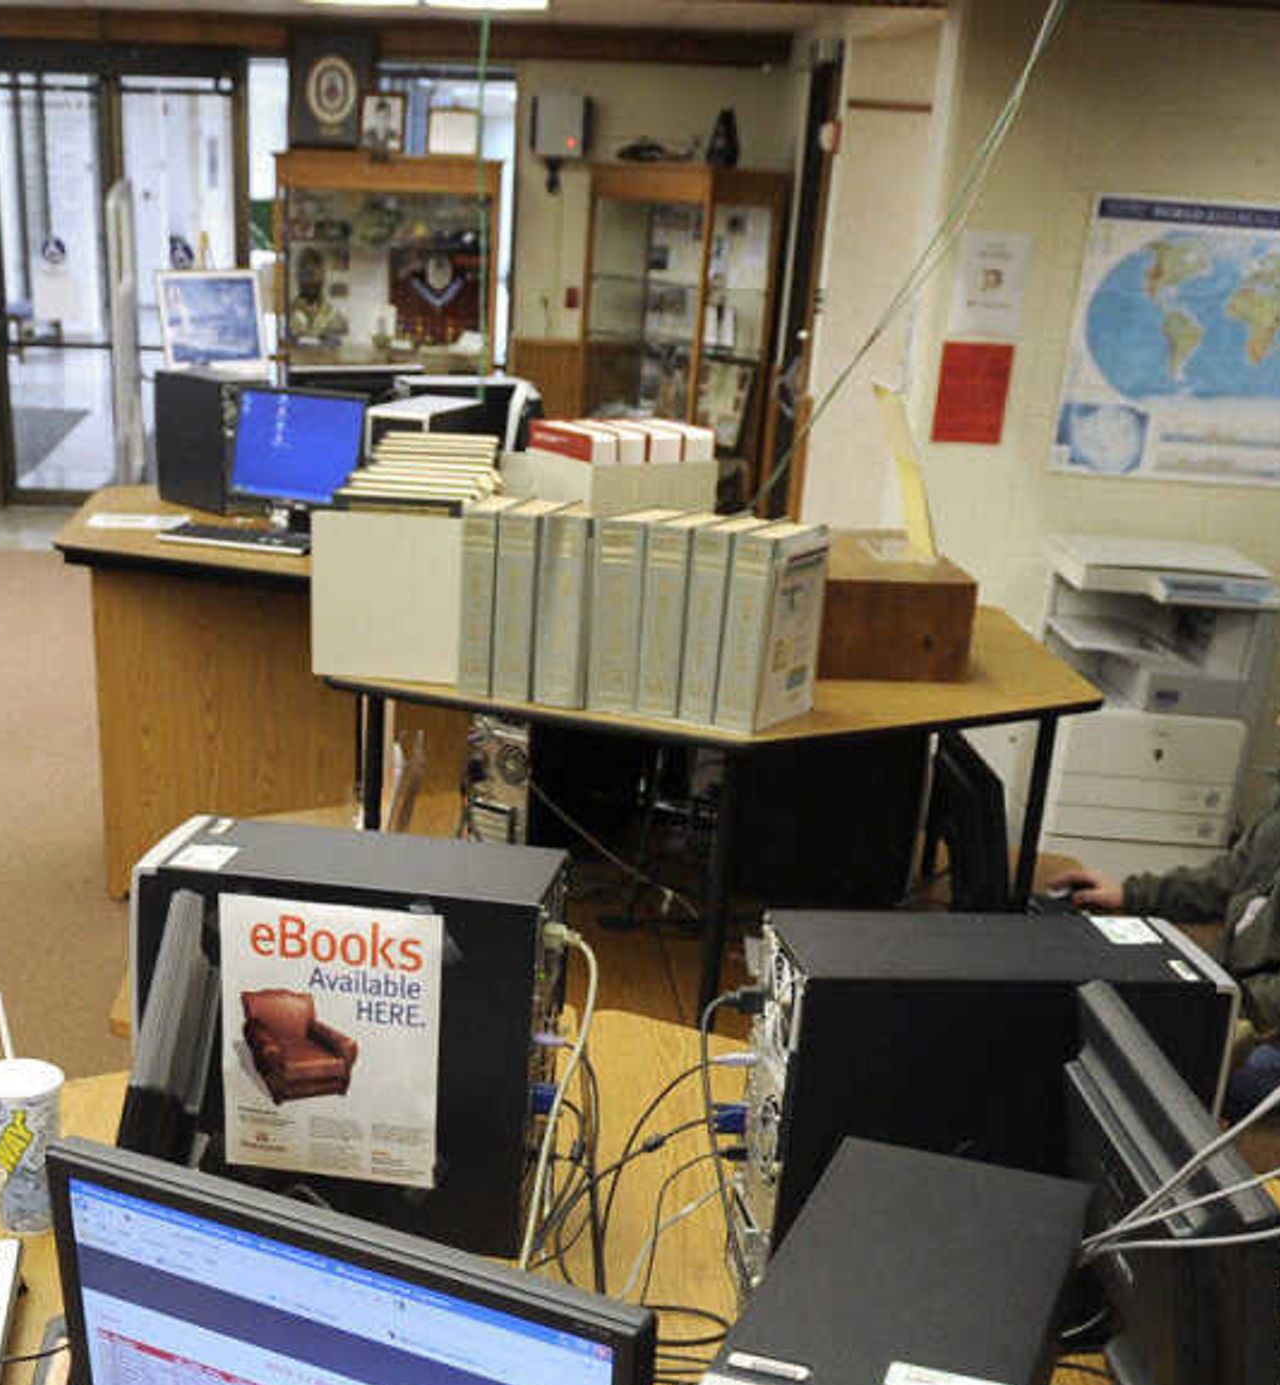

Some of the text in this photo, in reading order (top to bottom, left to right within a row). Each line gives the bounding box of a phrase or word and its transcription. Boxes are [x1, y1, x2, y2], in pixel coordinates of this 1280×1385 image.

[249, 914, 425, 973] eBooks
[308, 966, 422, 1000] Available
[356, 1000, 427, 1028] HERE.
